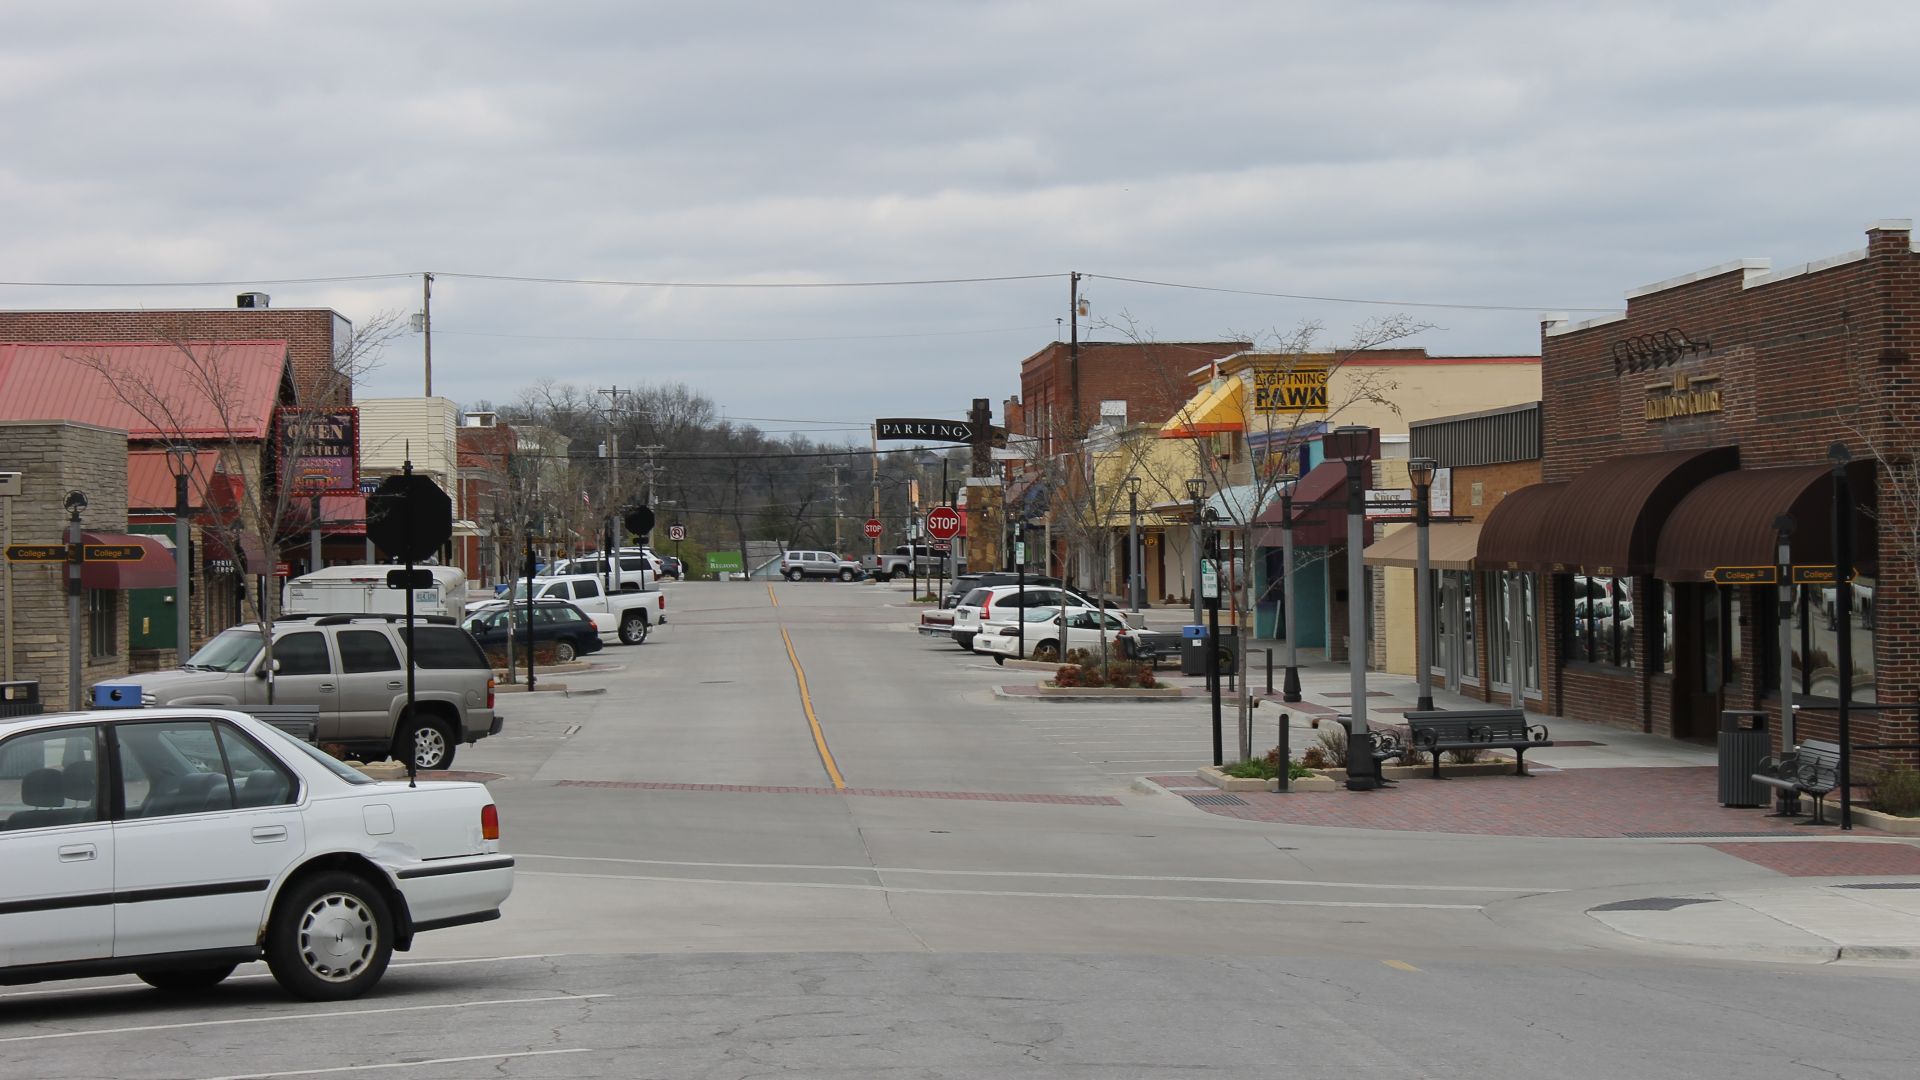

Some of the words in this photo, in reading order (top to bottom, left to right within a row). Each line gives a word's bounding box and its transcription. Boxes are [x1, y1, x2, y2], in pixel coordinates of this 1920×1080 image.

[1256, 373, 1326, 385] LIGHTNING
[1257, 387, 1326, 406] PAWN
[287, 424, 343, 439] OWEN
[883, 424, 963, 437] PARKING
[286, 446, 340, 455] TEATRE
[929, 517, 958, 529] STOP
[18, 549, 46, 558] College
[94, 549, 122, 558] College
[1726, 570, 1755, 580] College
[1803, 570, 1833, 580] College
